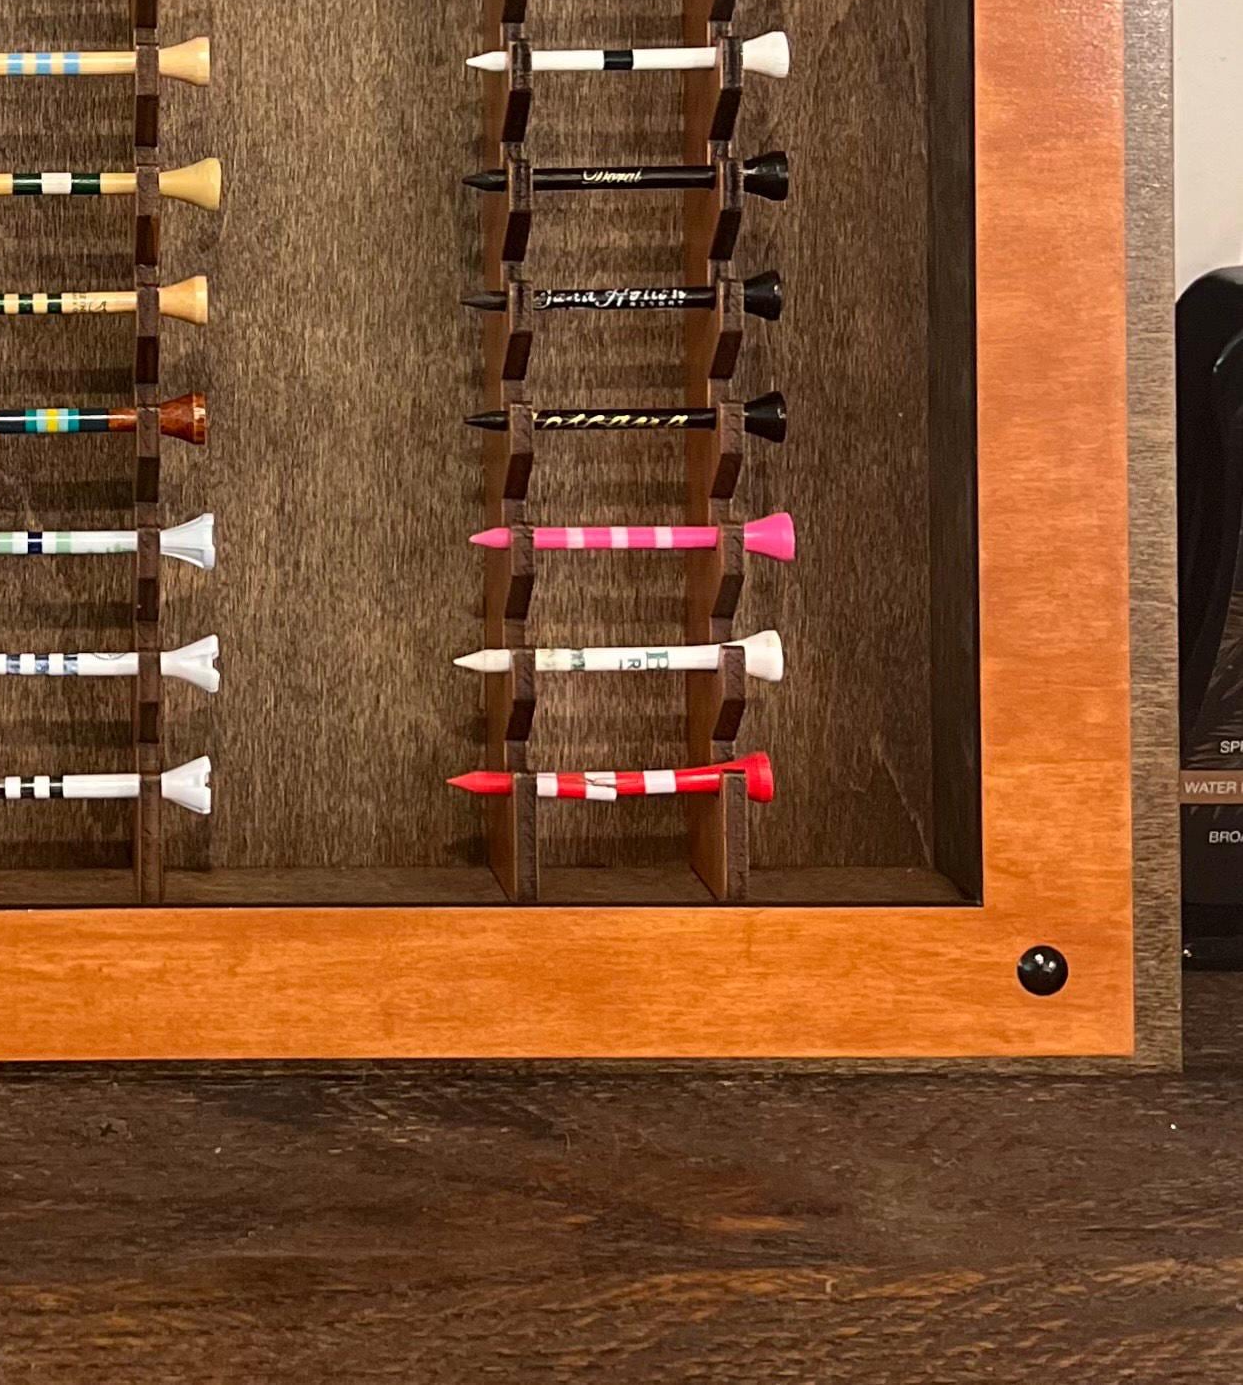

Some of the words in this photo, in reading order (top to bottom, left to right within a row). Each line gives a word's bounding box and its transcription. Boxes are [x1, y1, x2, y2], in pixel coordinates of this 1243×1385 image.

[1219, 740, 1243, 754] SP
[1184, 781, 1238, 794] WATER
[1209, 830, 1243, 843] BRO
